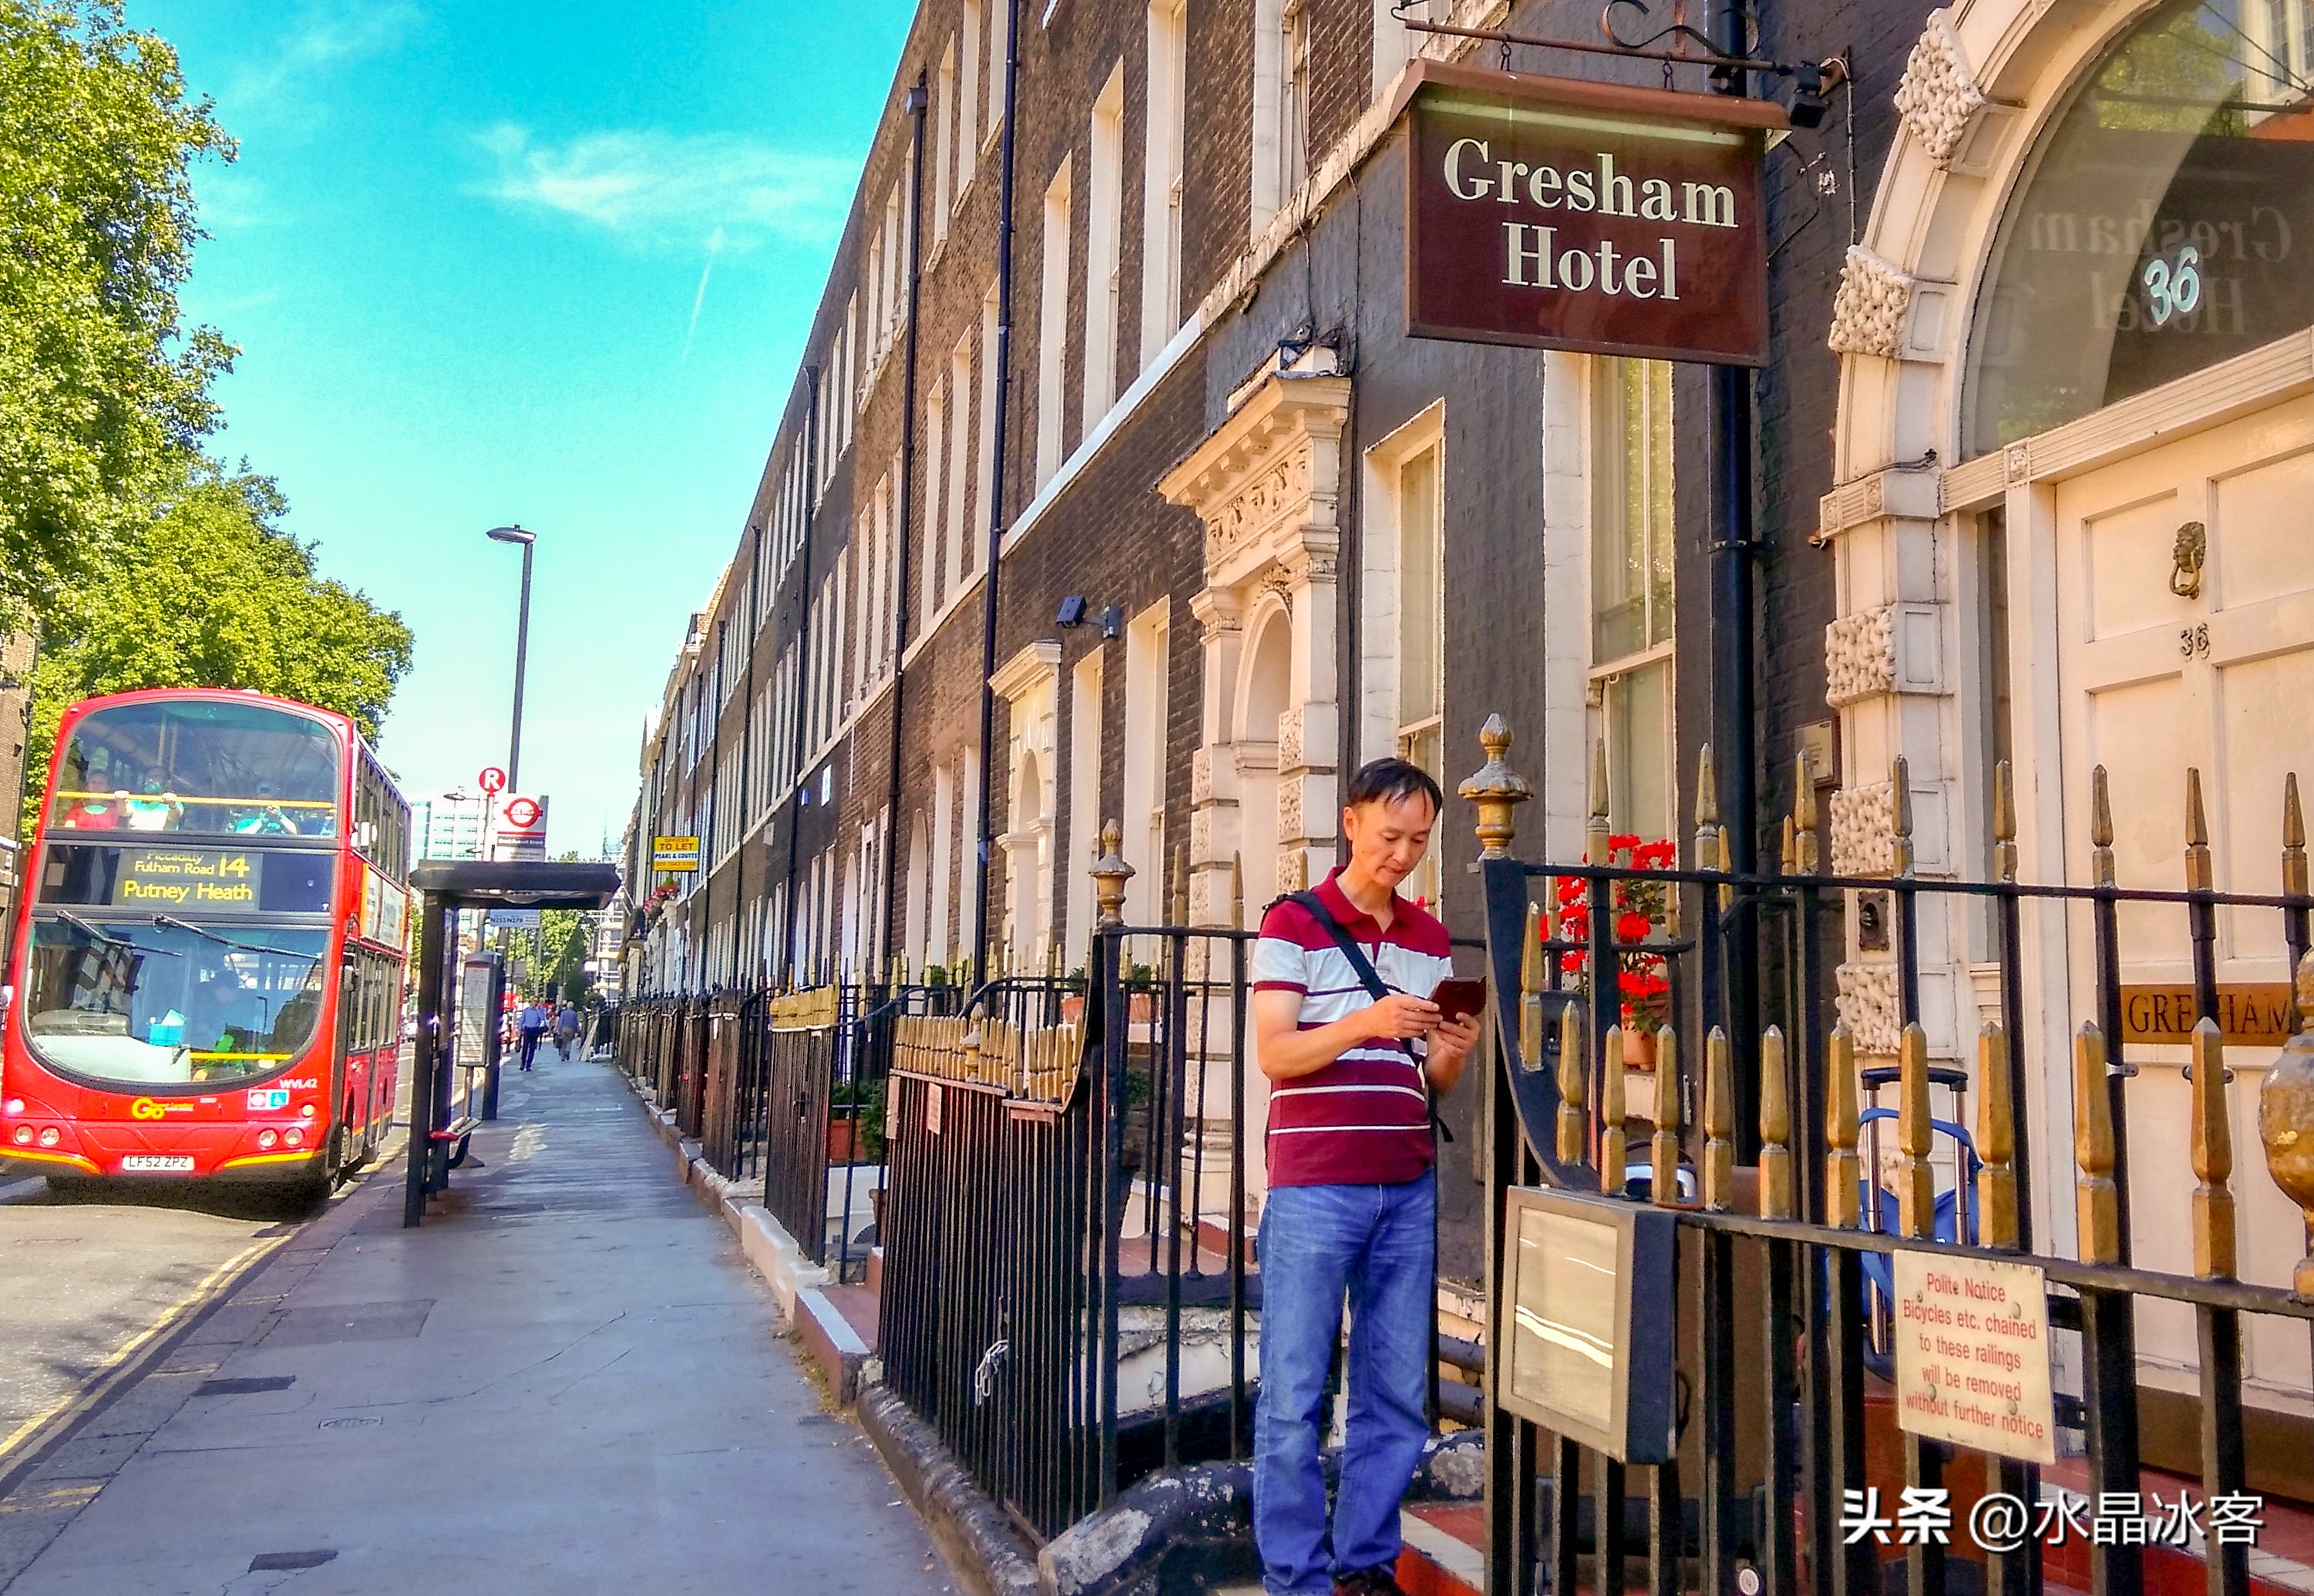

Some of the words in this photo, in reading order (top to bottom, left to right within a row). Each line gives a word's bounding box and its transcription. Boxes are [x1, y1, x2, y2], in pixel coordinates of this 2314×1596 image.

[1444, 137, 1739, 228] Gresham
[1502, 221, 1680, 301] Hotel
[2144, 245, 2200, 325] 36
[2179, 623, 2210, 660] 36
[484, 769, 501, 789] R
[134, 860, 180, 873] Fulham
[184, 862, 215, 875] Road
[146, 850, 203, 865] Piccadilly
[219, 852, 250, 878] 14
[123, 879, 190, 903] Putney
[196, 882, 253, 901] Heath
[2128, 994, 2296, 1034] GREHAM
[279, 1078, 318, 1089] WVL42
[132, 1097, 164, 1119] Go
[129, 1157, 161, 1168] LF52
[164, 1158, 188, 1168] ZPZ
[1927, 1272, 1959, 1295] Polite
[1965, 1278, 2006, 1302] Notice
[1903, 1299, 1952, 1325] Bicycles
[1957, 1310, 1980, 1330] etc.
[1986, 1313, 2037, 1339] chained
[1919, 1332, 1932, 1352] to
[1936, 1336, 1970, 1359] these
[1976, 1344, 2021, 1373] railings
[1922, 1364, 1941, 1384] will
[1946, 1367, 1961, 1388] be
[1966, 1376, 2022, 1402] removed
[1905, 1391, 1949, 1416] without
[1954, 1399, 1996, 1426] further
[2002, 1413, 2043, 1439] notice
